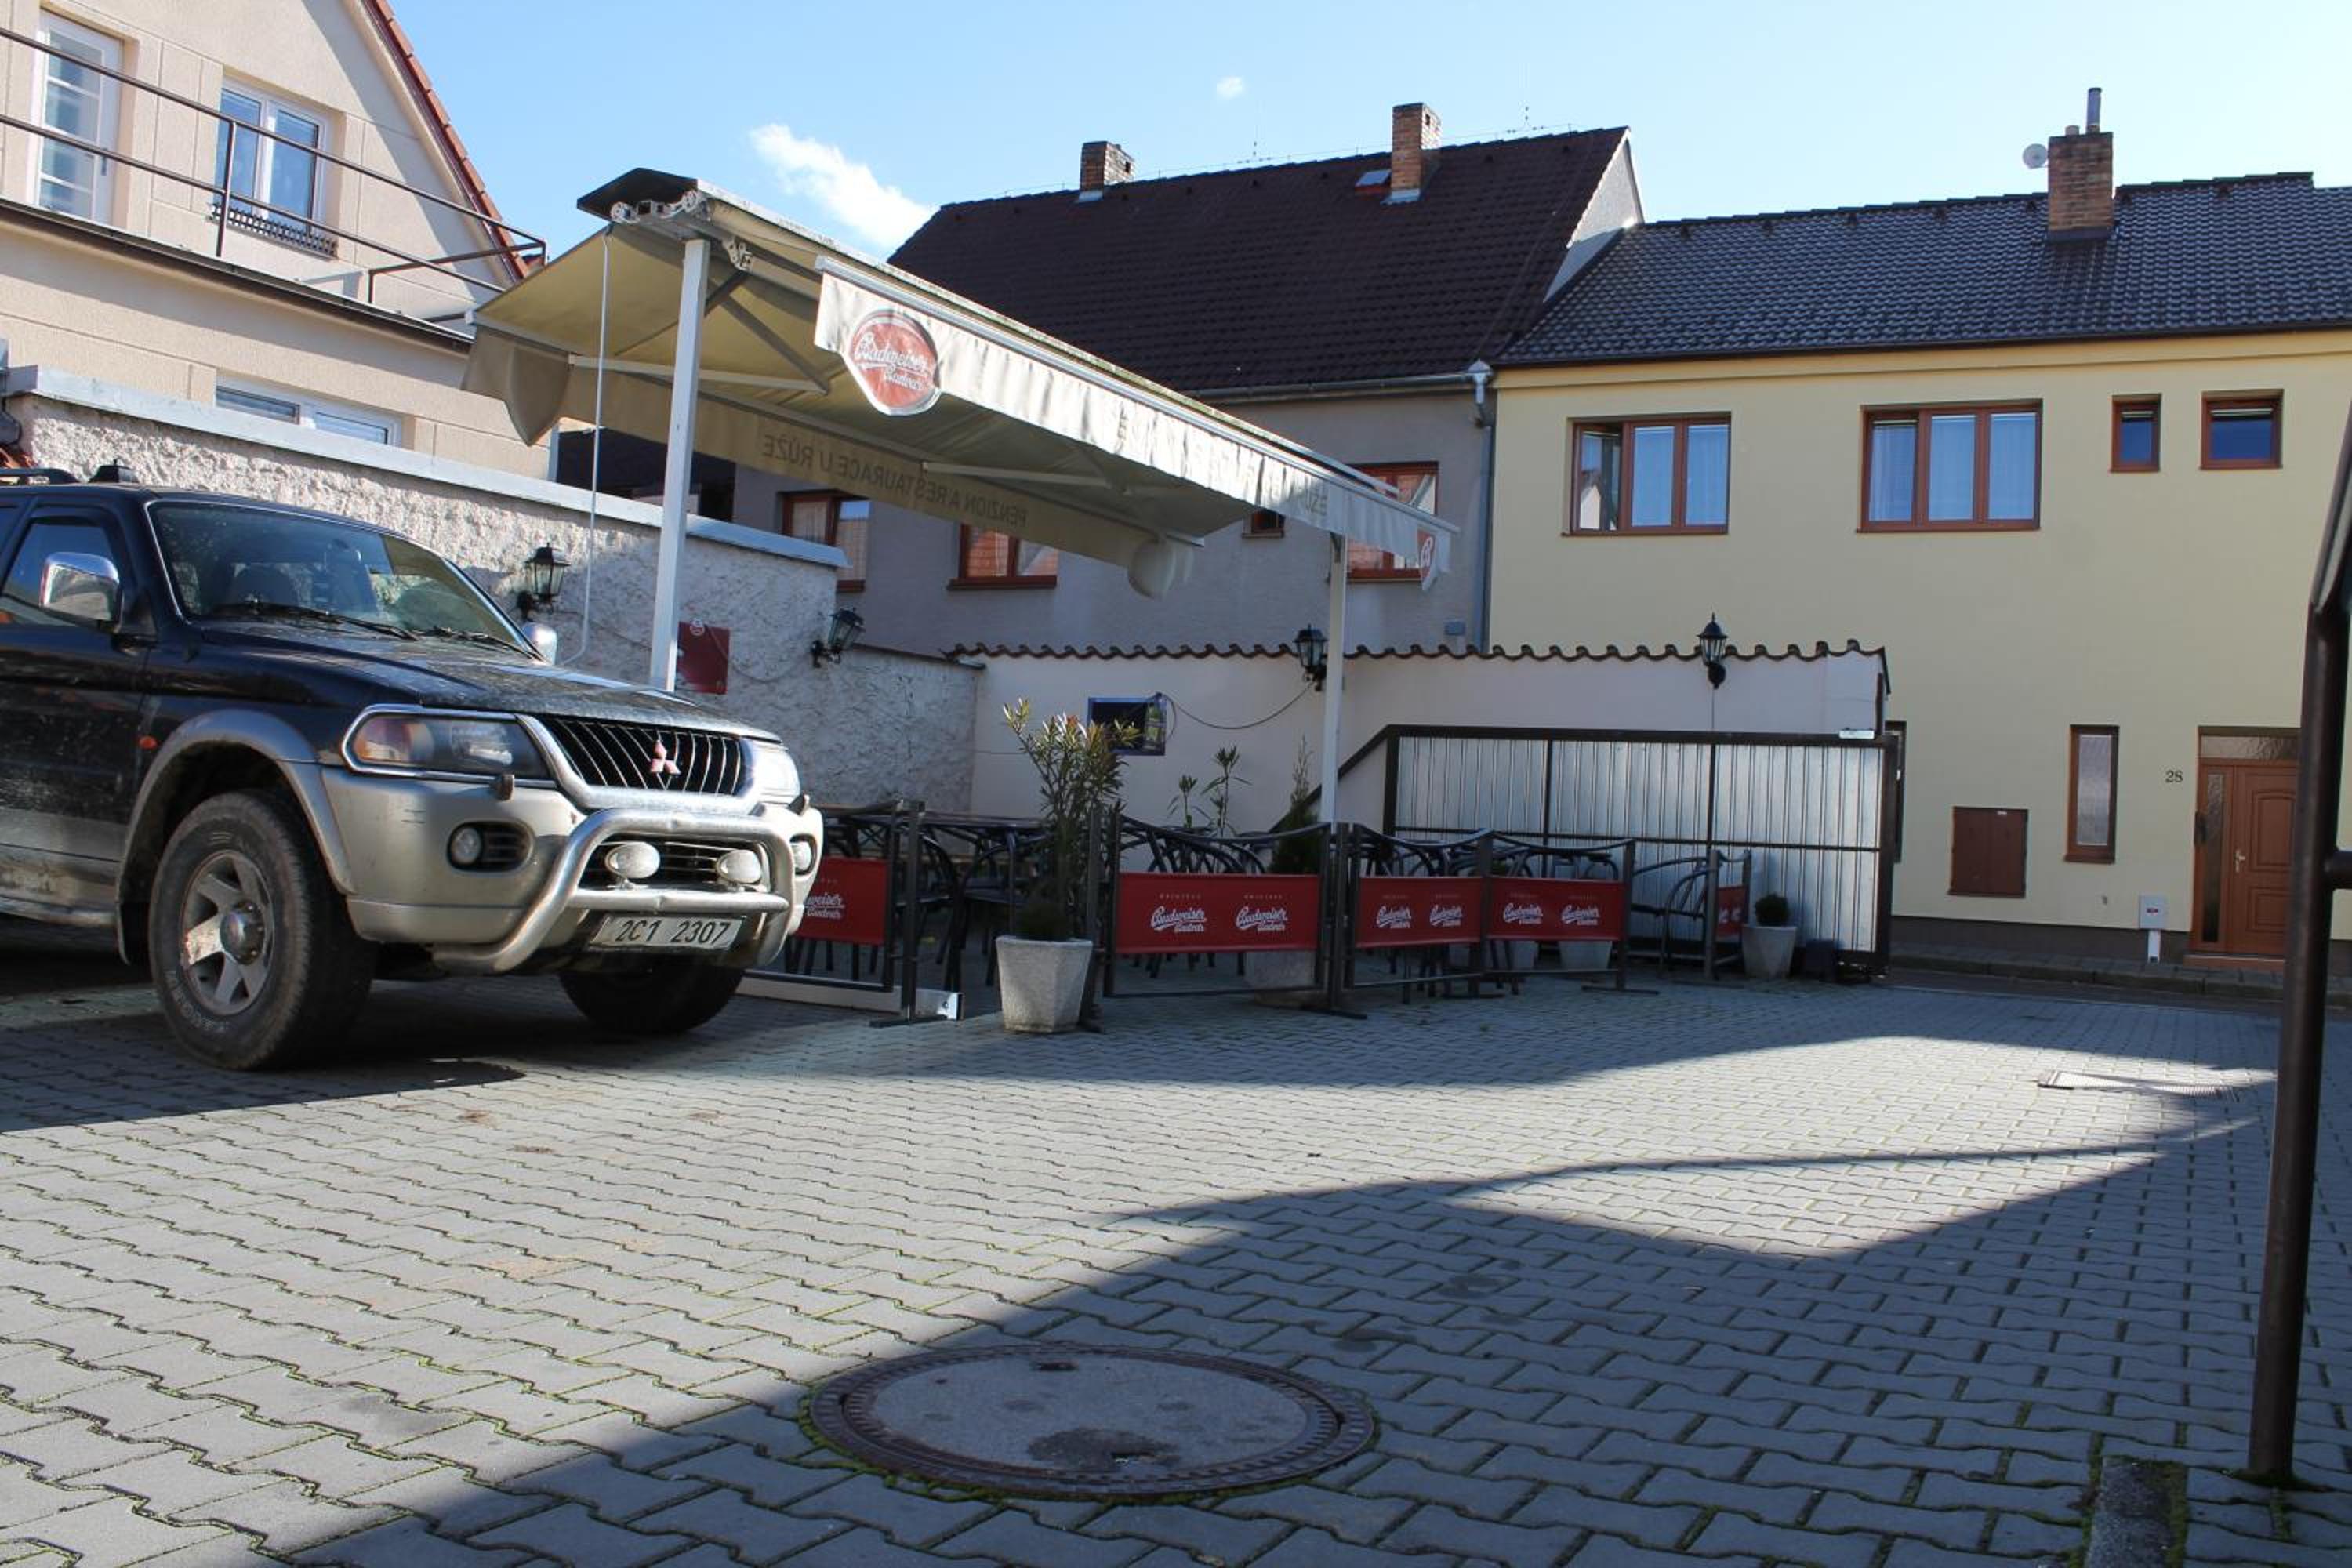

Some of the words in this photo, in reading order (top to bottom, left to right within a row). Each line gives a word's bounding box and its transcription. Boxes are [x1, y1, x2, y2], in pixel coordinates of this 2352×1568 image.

[2165, 769, 2183, 783] 28
[615, 920, 662, 942] 2C1
[670, 920, 731, 945] 2307
